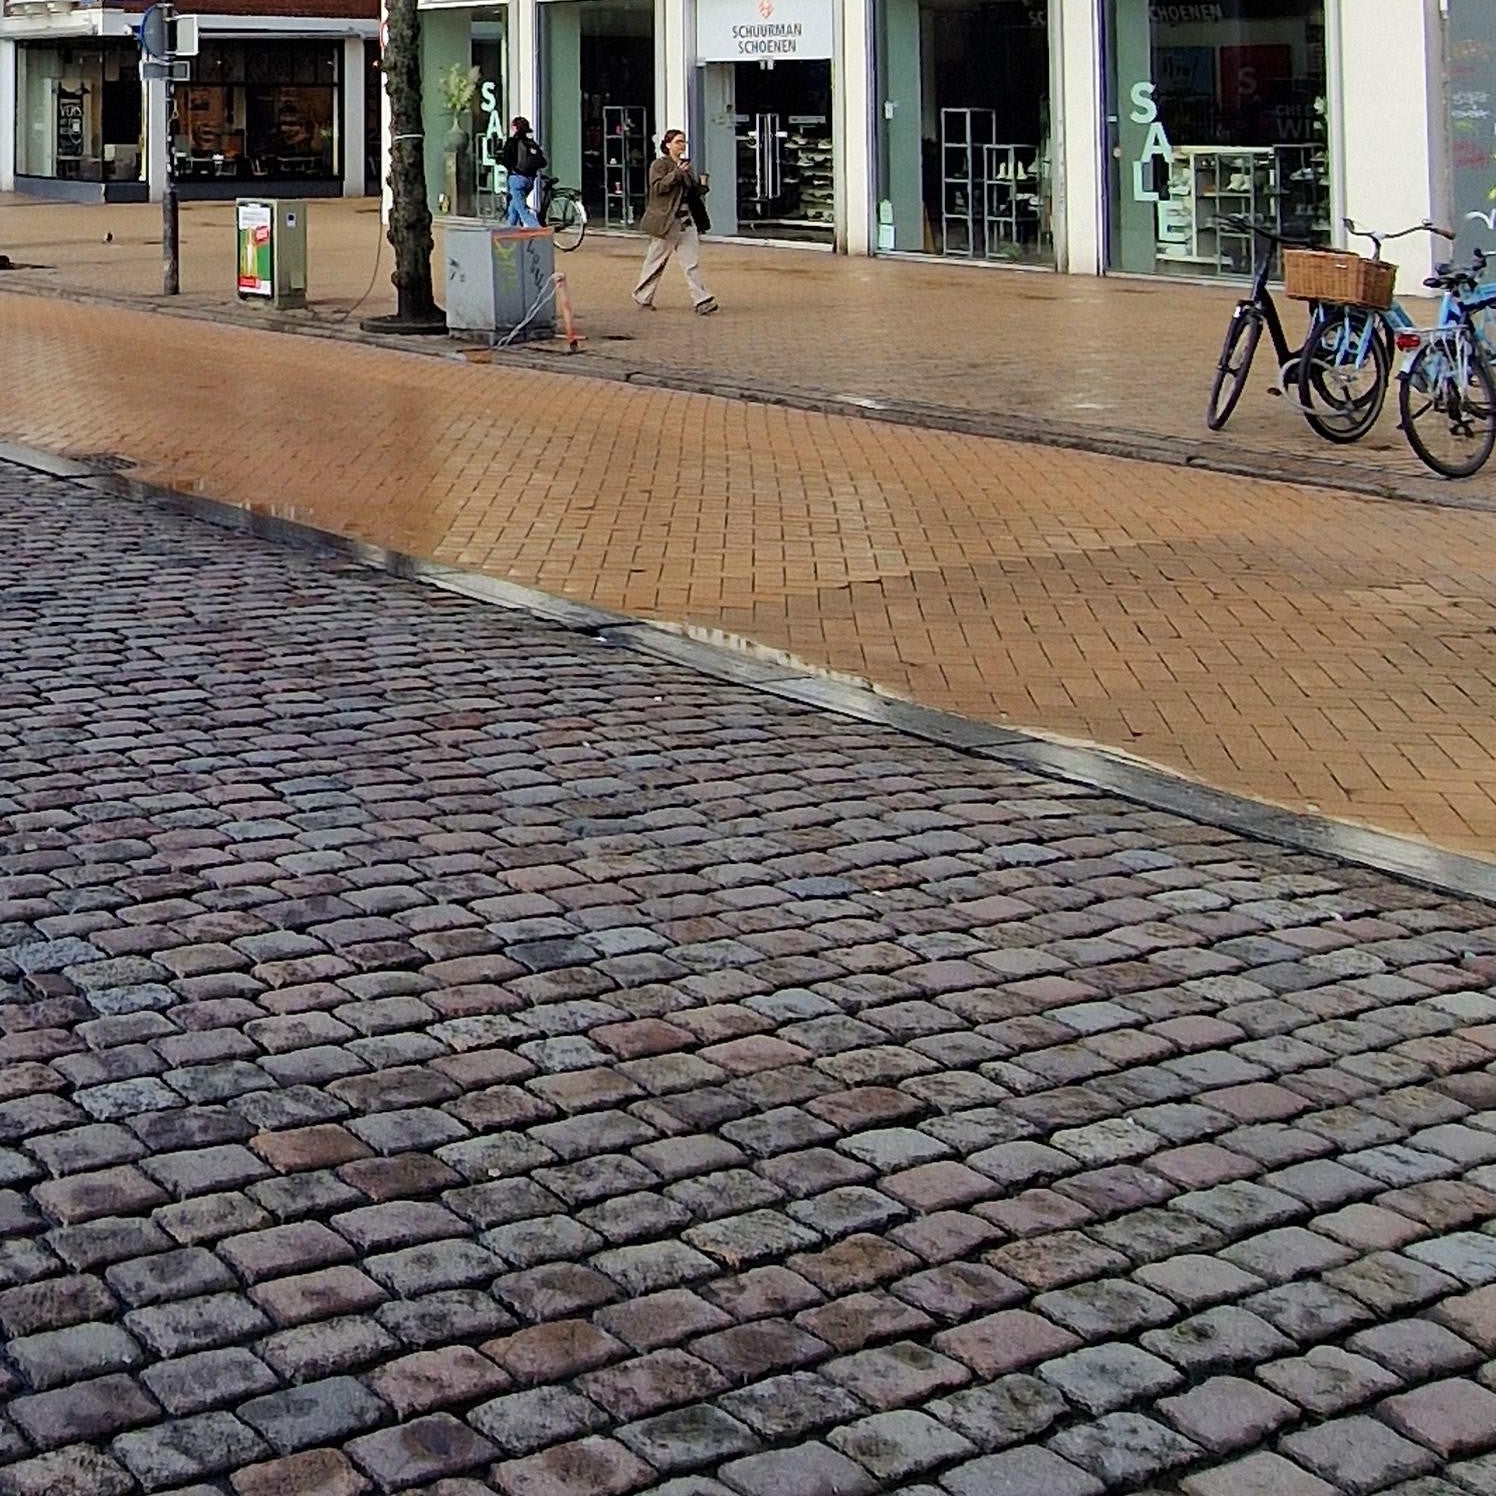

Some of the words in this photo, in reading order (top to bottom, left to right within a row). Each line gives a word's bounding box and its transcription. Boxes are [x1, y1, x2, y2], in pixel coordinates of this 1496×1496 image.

[731, 23, 803, 39] SCHUURMAN
[737, 39, 797, 54] SCHOENEN
[480, 81, 509, 194] SALE
[1129, 81, 1188, 242] SALE
